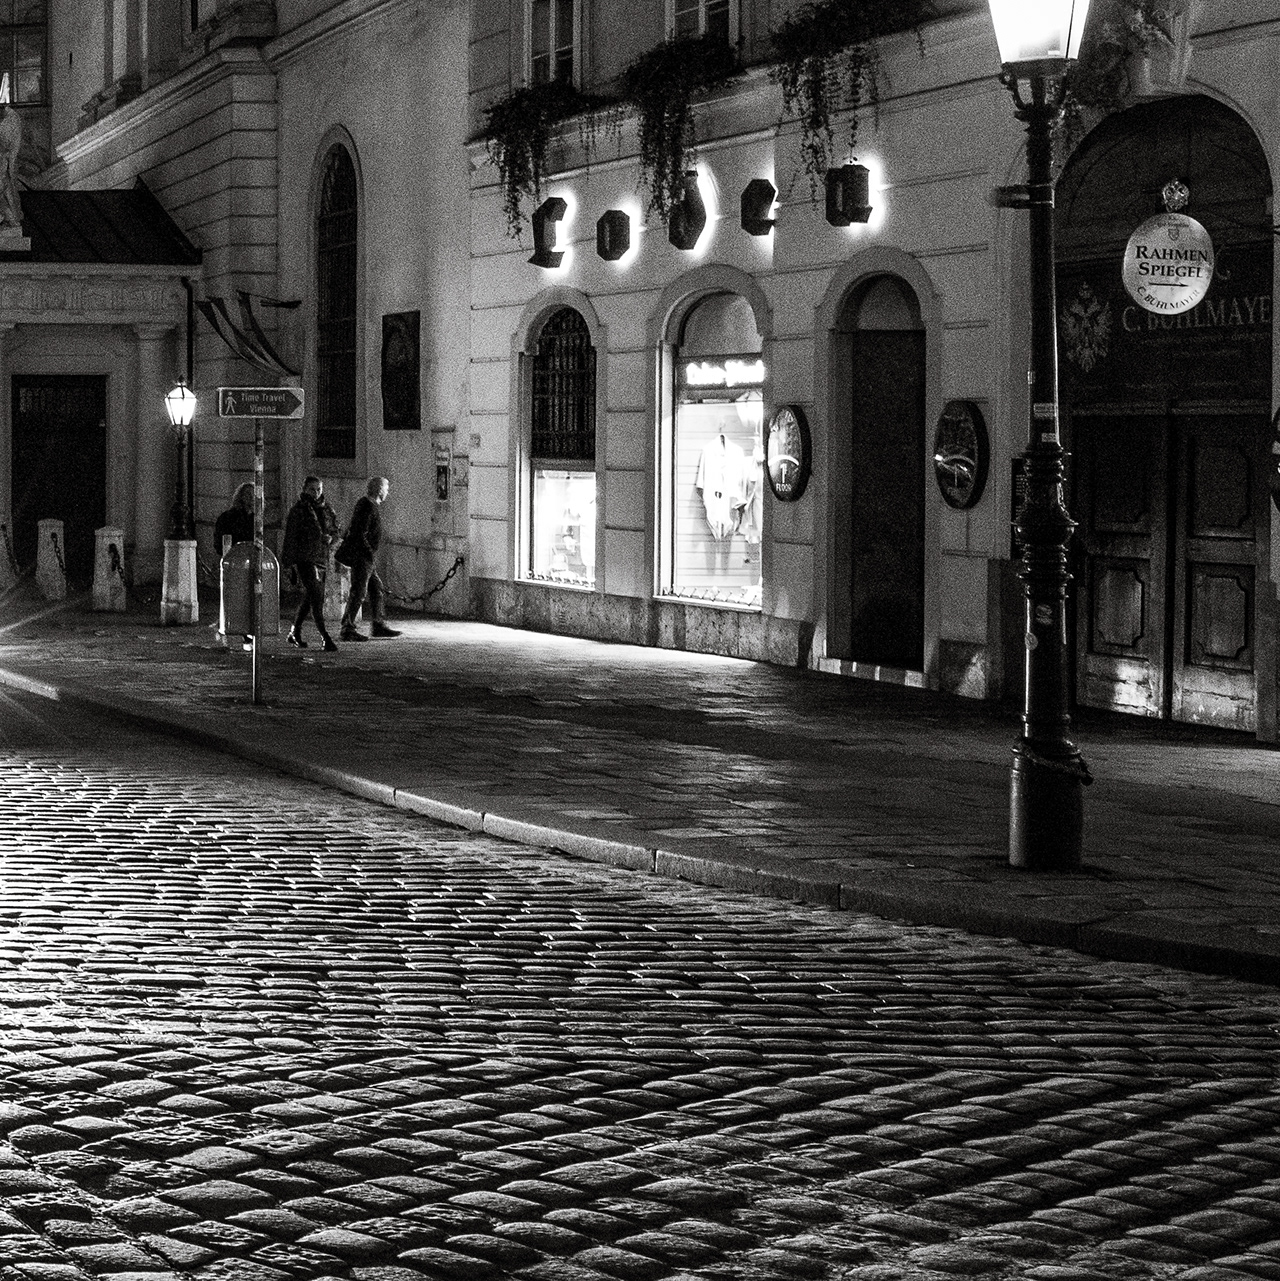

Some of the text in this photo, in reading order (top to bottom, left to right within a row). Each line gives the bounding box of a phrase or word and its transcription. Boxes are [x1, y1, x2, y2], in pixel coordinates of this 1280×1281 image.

[1135, 245, 1209, 262] RAHMEN
[1138, 261, 1203, 278] SPIEGEL
[241, 392, 286, 402] Time Travel
[249, 404, 277, 413] Vienna
